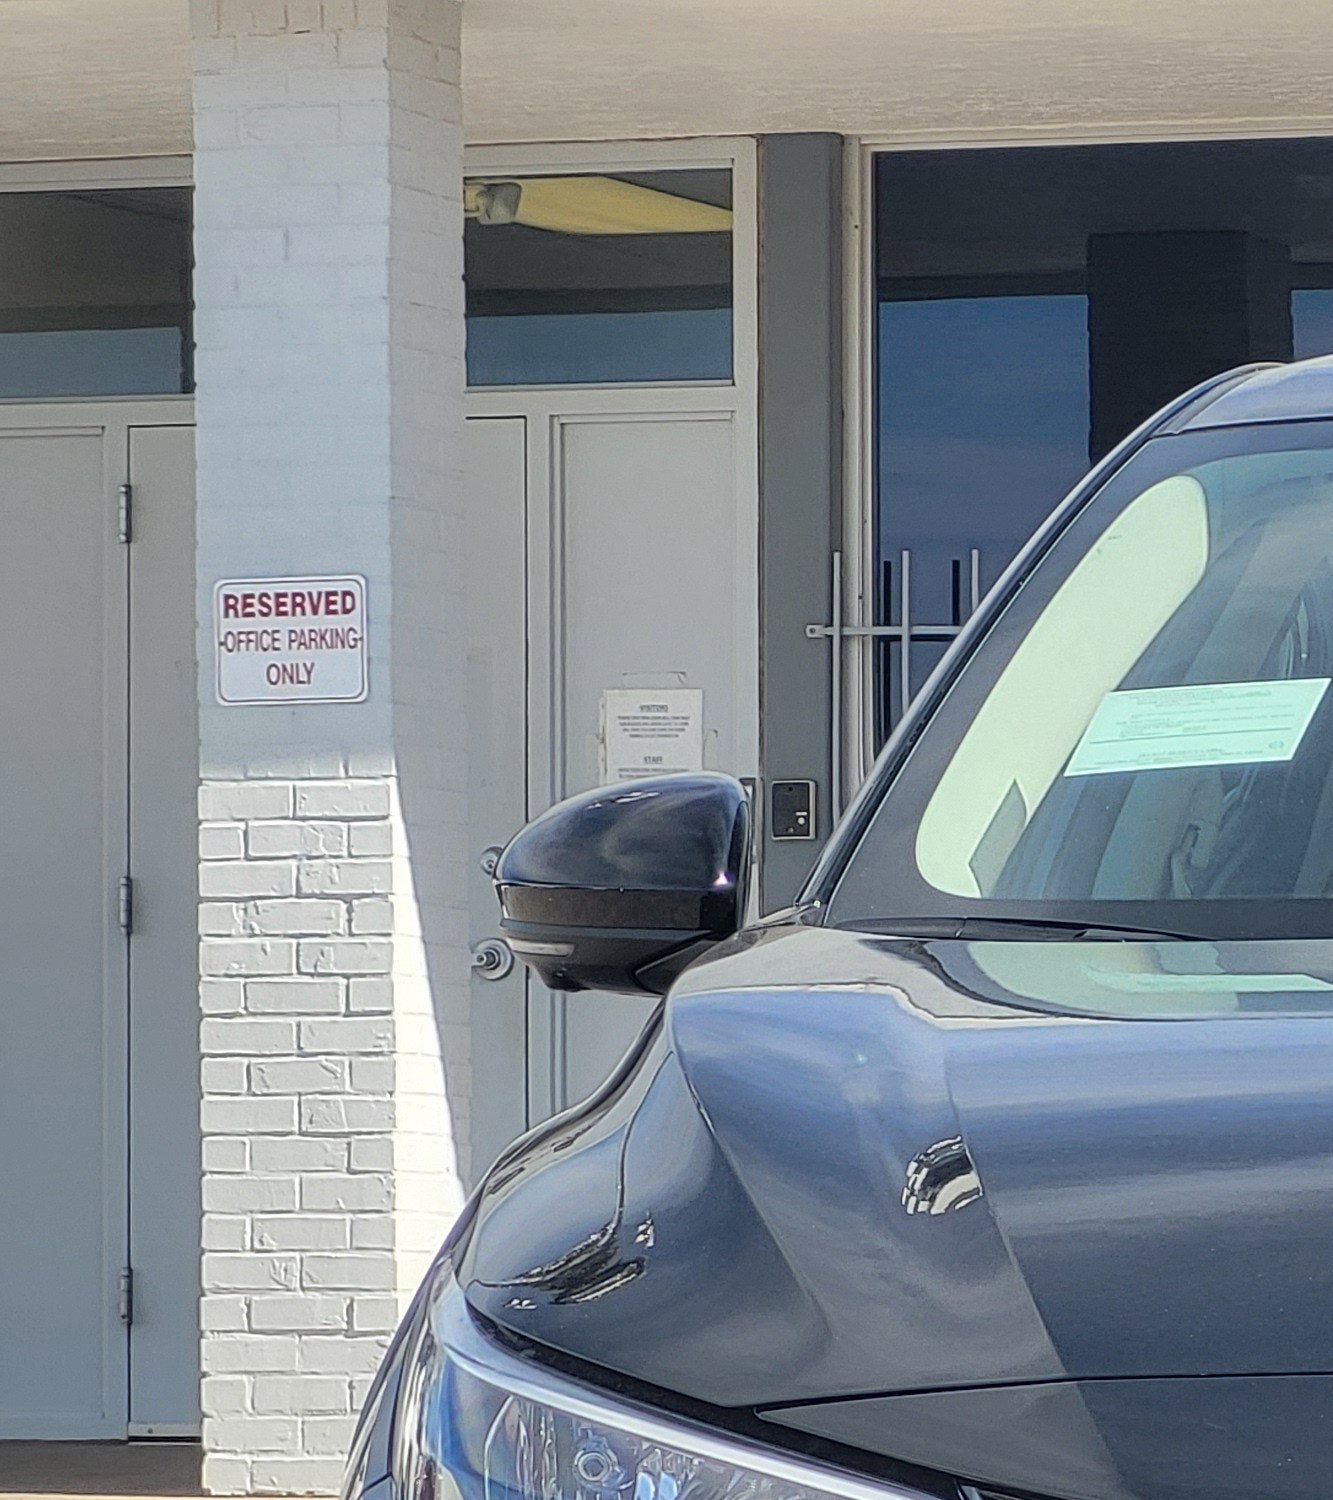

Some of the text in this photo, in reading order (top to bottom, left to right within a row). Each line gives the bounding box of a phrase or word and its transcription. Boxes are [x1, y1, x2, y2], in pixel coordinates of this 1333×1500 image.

[223, 590, 356, 619] RESERVED
[224, 627, 358, 653] OFFICE PARKING
[266, 662, 315, 686] ONLY
